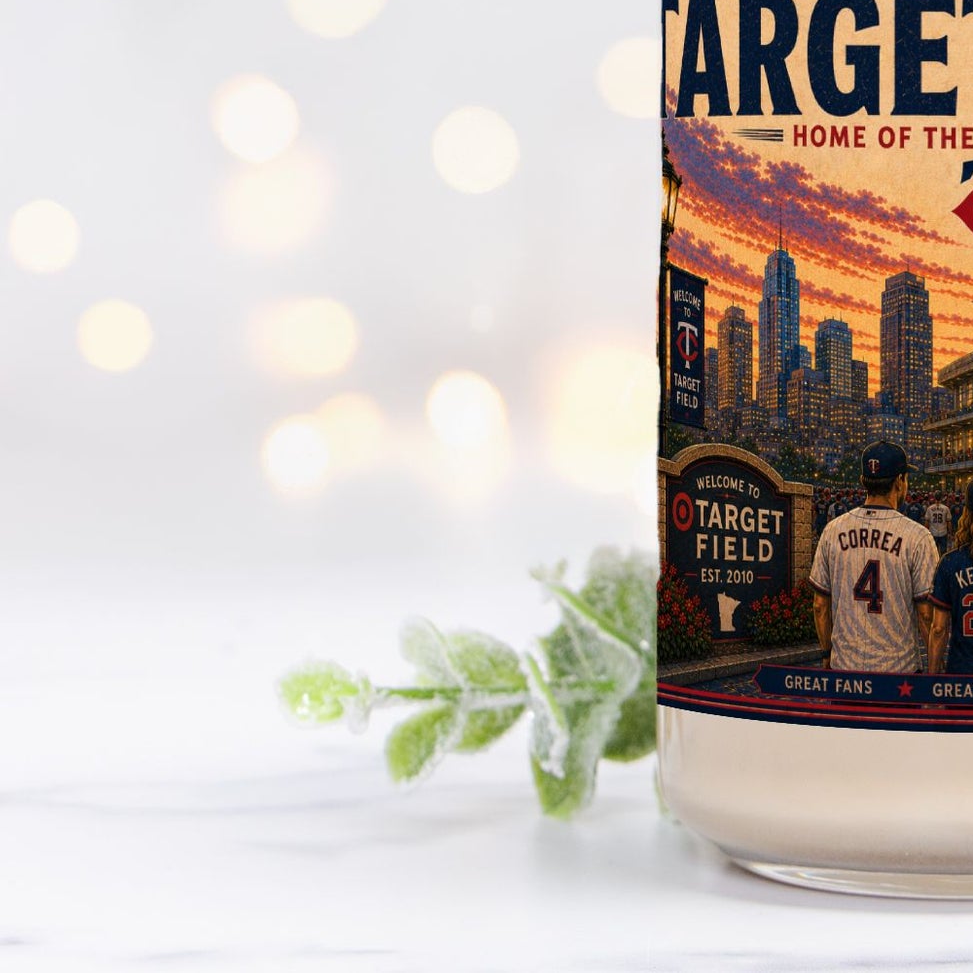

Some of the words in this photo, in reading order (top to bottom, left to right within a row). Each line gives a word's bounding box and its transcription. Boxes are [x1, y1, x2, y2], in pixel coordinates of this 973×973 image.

[793, 124, 866, 148] HOME
[878, 126, 911, 149] OF
[673, 290, 701, 311] WELCOME
[684, 307, 691, 318] TO
[674, 373, 700, 392] TARGET
[676, 391, 699, 409] FIELD
[696, 475, 744, 493] WELCOME
[748, 484, 760, 499] TO
[696, 499, 784, 535] TARGET
[696, 533, 774, 562] FIELD
[838, 528, 903, 557] CORREA
[701, 568, 723, 584] EST.
[727, 570, 754, 584] 2010
[853, 559, 883, 614] 4
[785, 675, 828, 692] GREAT
[835, 678, 873, 695] FANS
